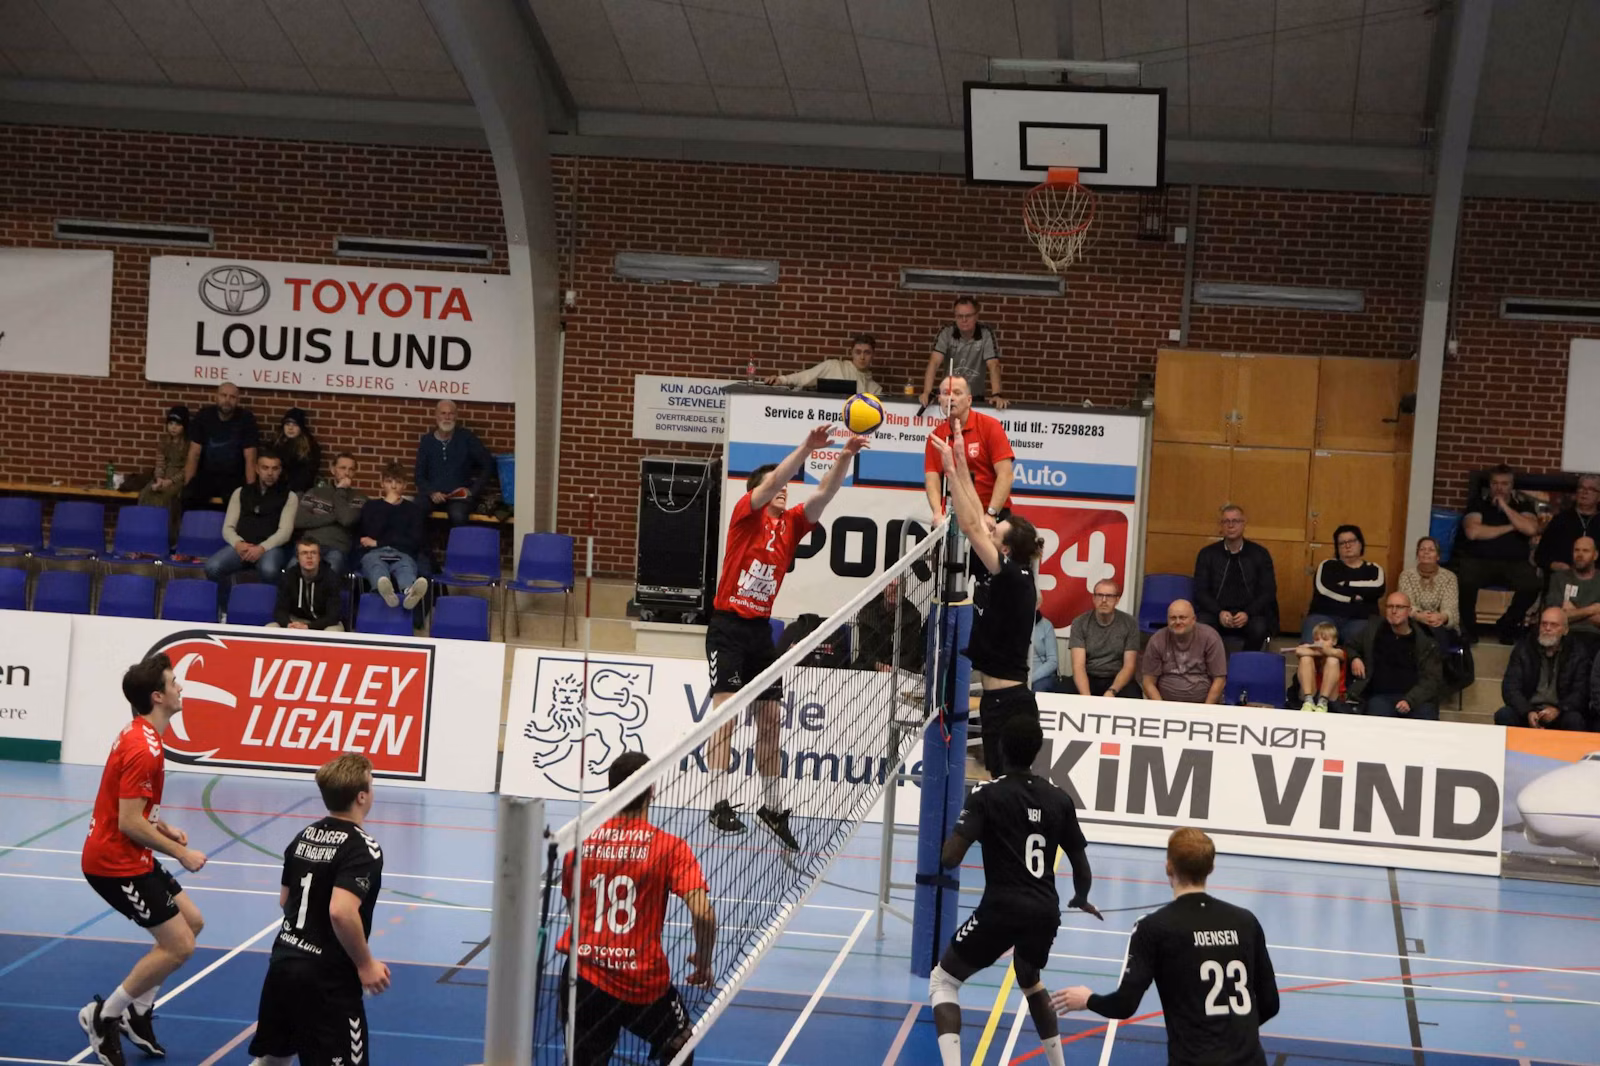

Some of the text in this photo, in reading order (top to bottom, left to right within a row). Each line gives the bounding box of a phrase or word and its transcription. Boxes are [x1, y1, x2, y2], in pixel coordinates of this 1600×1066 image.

[284, 277, 473, 322] TOYOTA
[195, 321, 472, 372] LOUIS LUND
[194, 366, 470, 395] RIBE VEJEN ESBJERG VARDE
[660, 383, 726, 396] KUN ADGAN
[668, 397, 726, 409] STÆVNELE
[655, 423, 708, 433] BORTVISNING
[656, 413, 718, 424] OVERTRÆDELSE
[764, 406, 804, 420] Service
[807, 408, 815, 420] &
[886, 413, 910, 427] Ring
[1014, 420, 1028, 432] tid
[1051, 423, 1105, 437] 75298283
[810, 461, 834, 470] Serv
[811, 450, 842, 461] BOSC
[1013, 463, 1067, 487] Auto
[765, 530, 776, 552] 2
[1036, 527, 1116, 595] 24
[249, 656, 418, 708] VOLLEY
[240, 704, 414, 756] LIGAEN
[1038, 709, 1326, 751] ENTREPRENØR
[302, 826, 349, 845] FOLDAGER
[1025, 833, 1047, 879] 6
[296, 872, 313, 929] 1
[589, 873, 637, 934] 18
[594, 945, 636, 958] TOYOTA
[1193, 929, 1240, 947] JOENSEN
[1200, 959, 1252, 1016] 23
